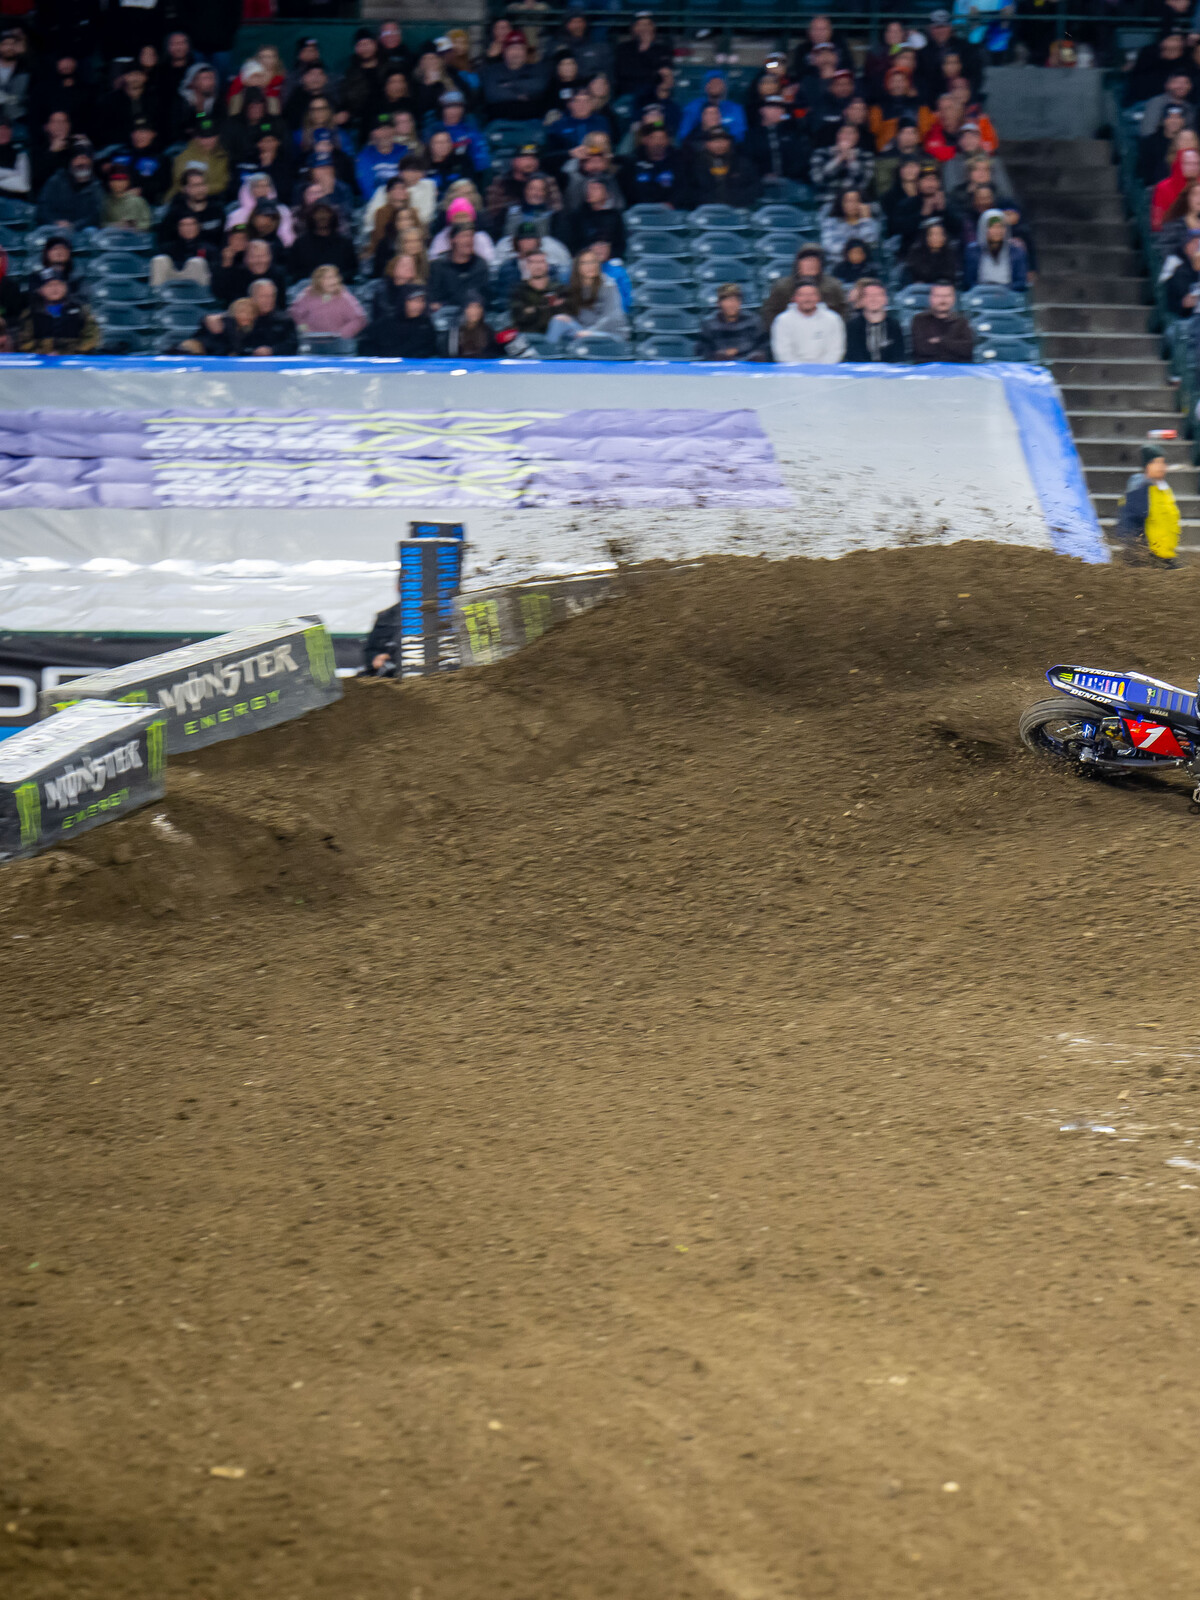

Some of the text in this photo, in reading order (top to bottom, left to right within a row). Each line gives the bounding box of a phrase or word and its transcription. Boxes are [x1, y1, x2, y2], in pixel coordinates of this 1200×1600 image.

[158, 644, 299, 715] MONSTER
[1070, 688, 1112, 704] DUNLOP
[184, 690, 281, 735] ENERGY
[1138, 726, 1167, 749] 1
[44, 740, 144, 809] MONSTER
[62, 787, 130, 829] ENERGY
